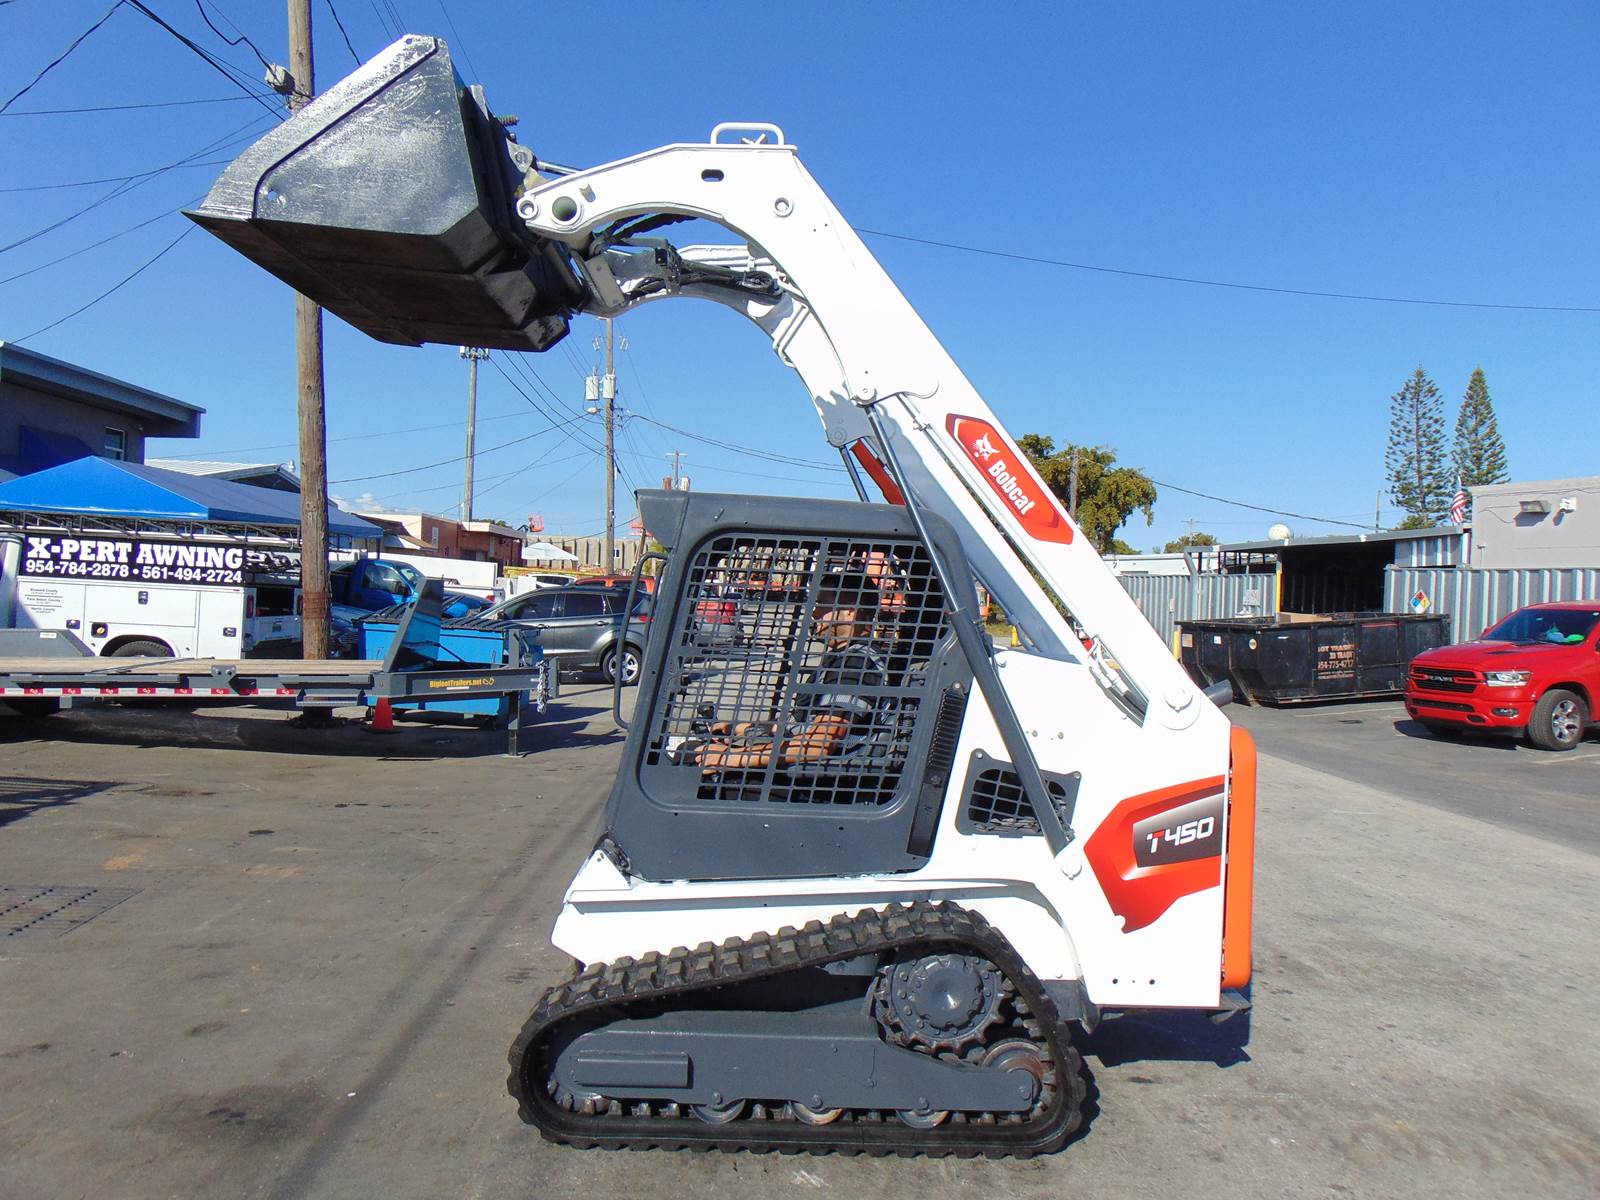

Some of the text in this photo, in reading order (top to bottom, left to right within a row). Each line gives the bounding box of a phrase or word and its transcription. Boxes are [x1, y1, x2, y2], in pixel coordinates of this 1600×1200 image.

[988, 460, 1036, 515] Bobcat
[27, 537, 243, 569] X-PERT AWNING
[26, 559, 242, 583] 954-784-2878 561-494-2724
[1146, 816, 1215, 853] T450
